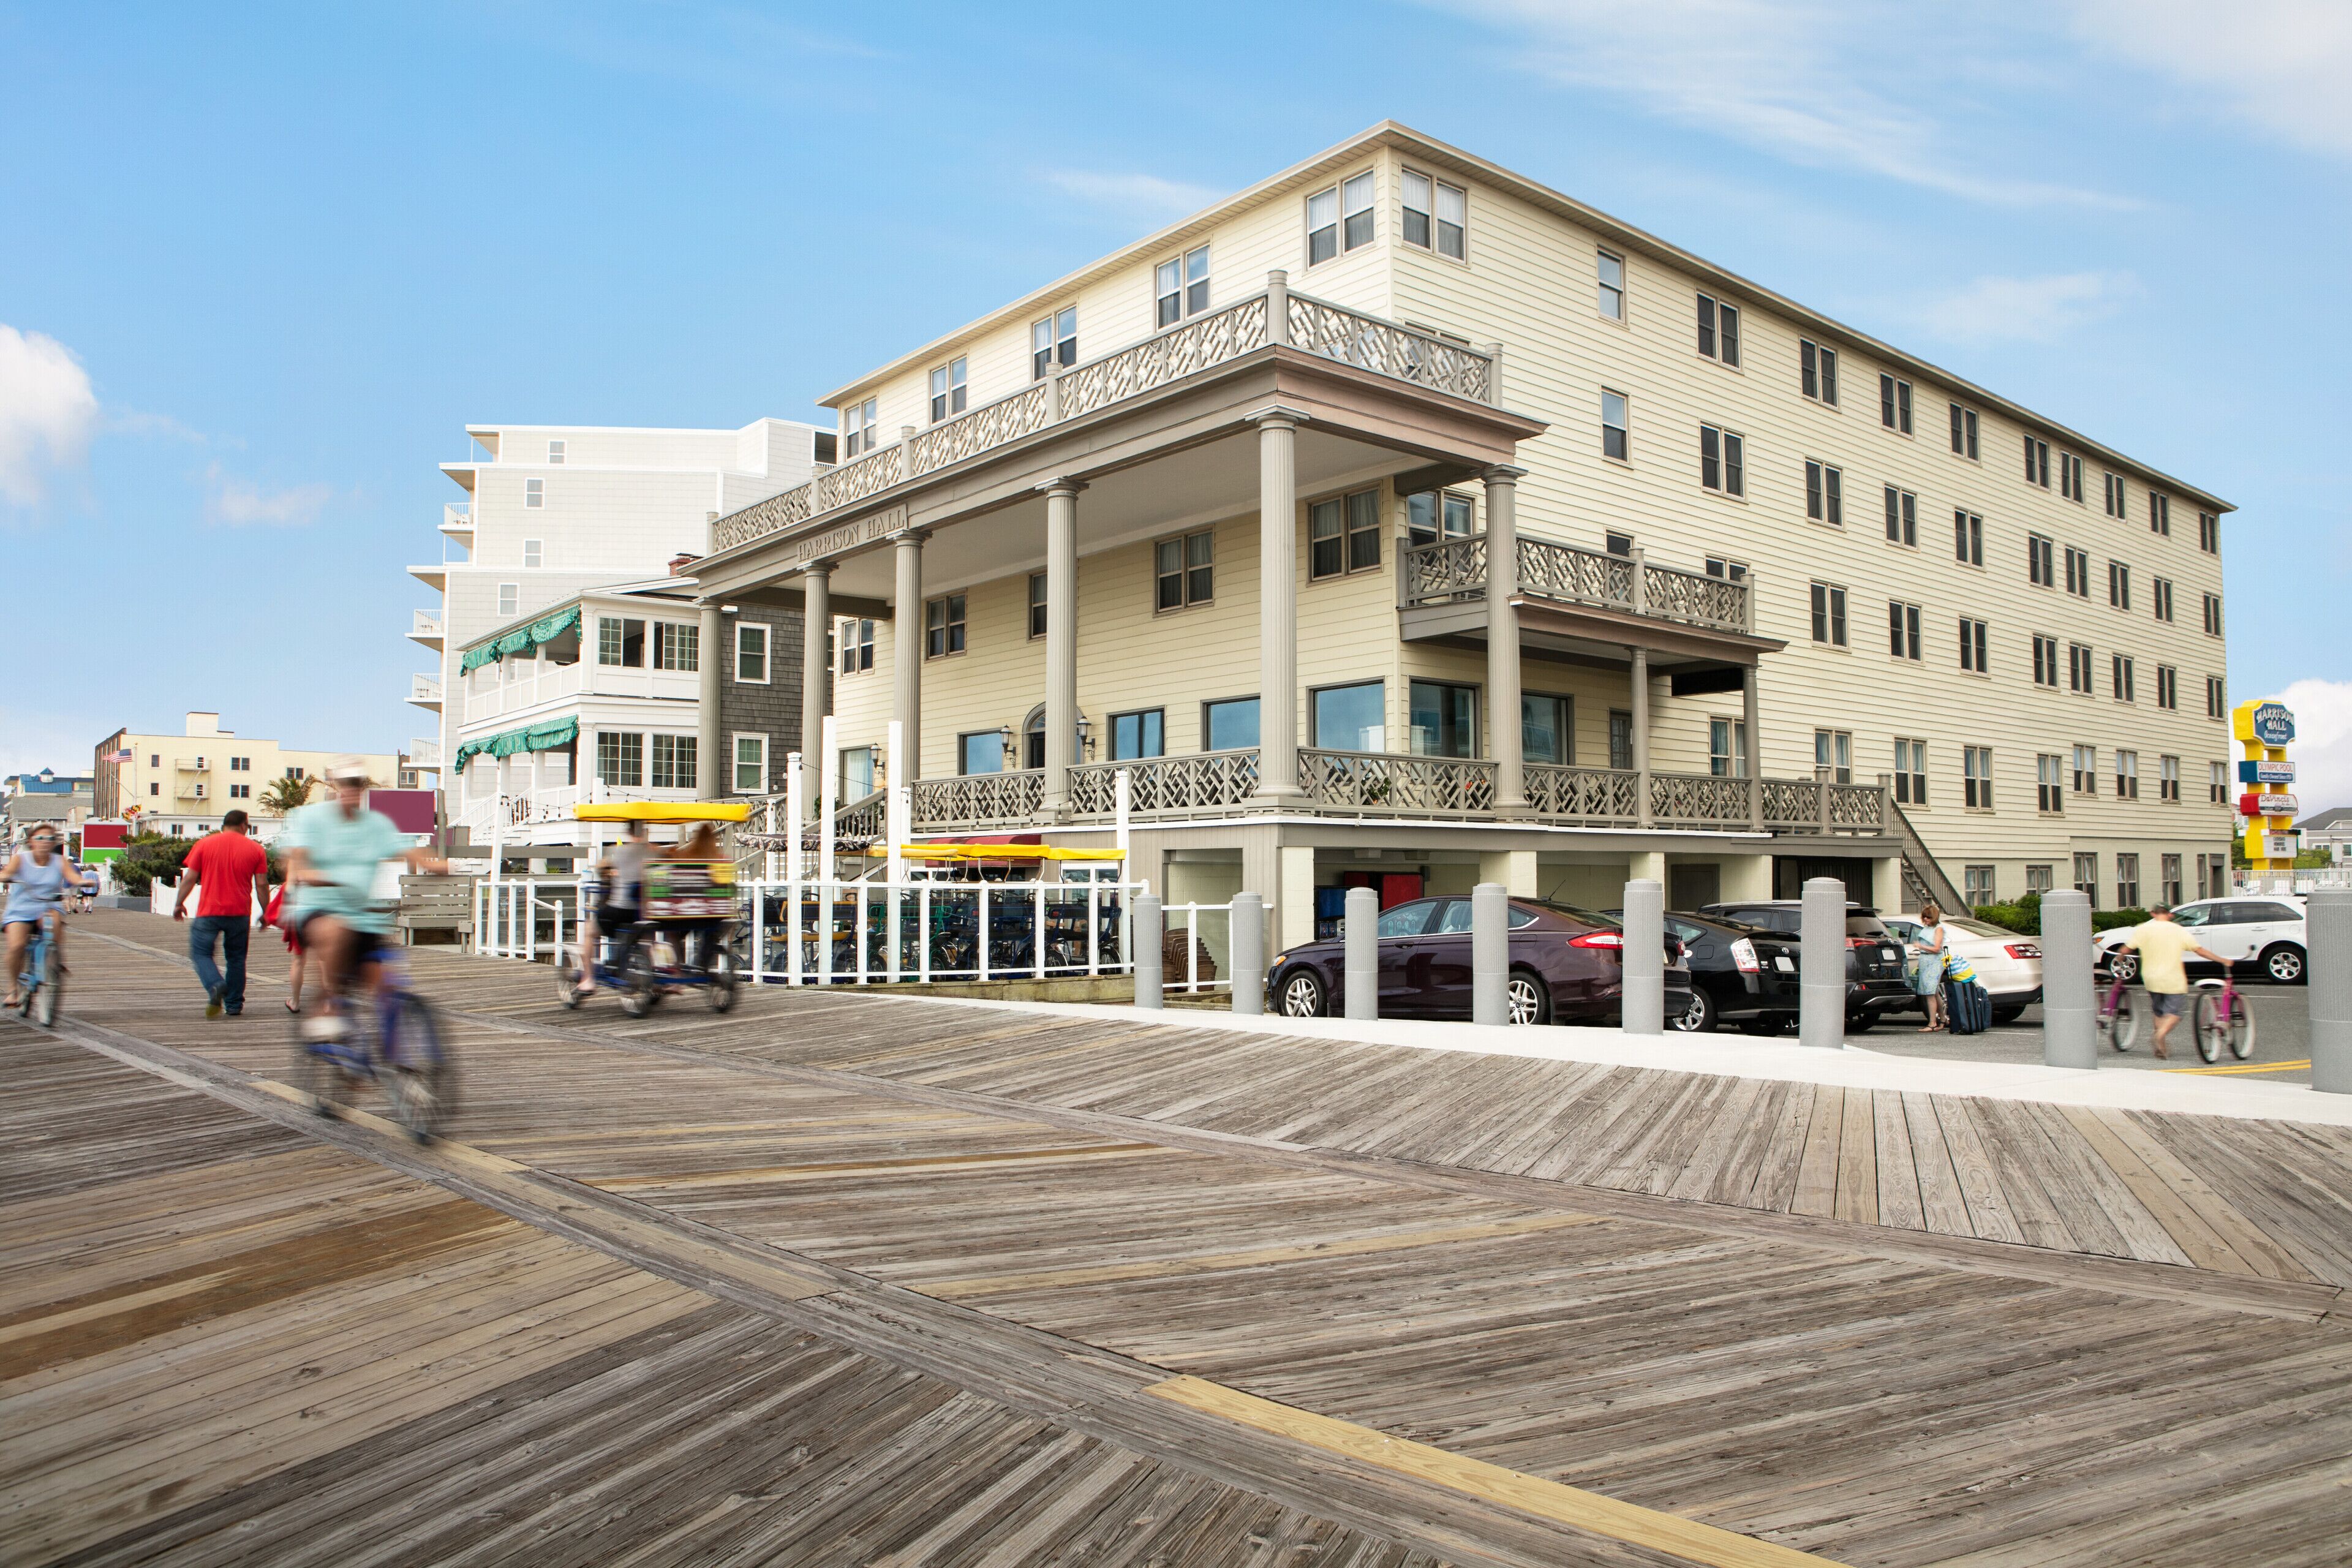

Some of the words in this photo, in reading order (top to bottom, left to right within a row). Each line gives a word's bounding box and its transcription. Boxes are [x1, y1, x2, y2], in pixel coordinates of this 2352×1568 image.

[798, 525, 859, 562] HARRISON
[867, 510, 905, 539] HALL
[2256, 707, 2294, 726] HARRISON
[2266, 720, 2286, 731] HALL
[2258, 763, 2279, 771] OLYMPIC
